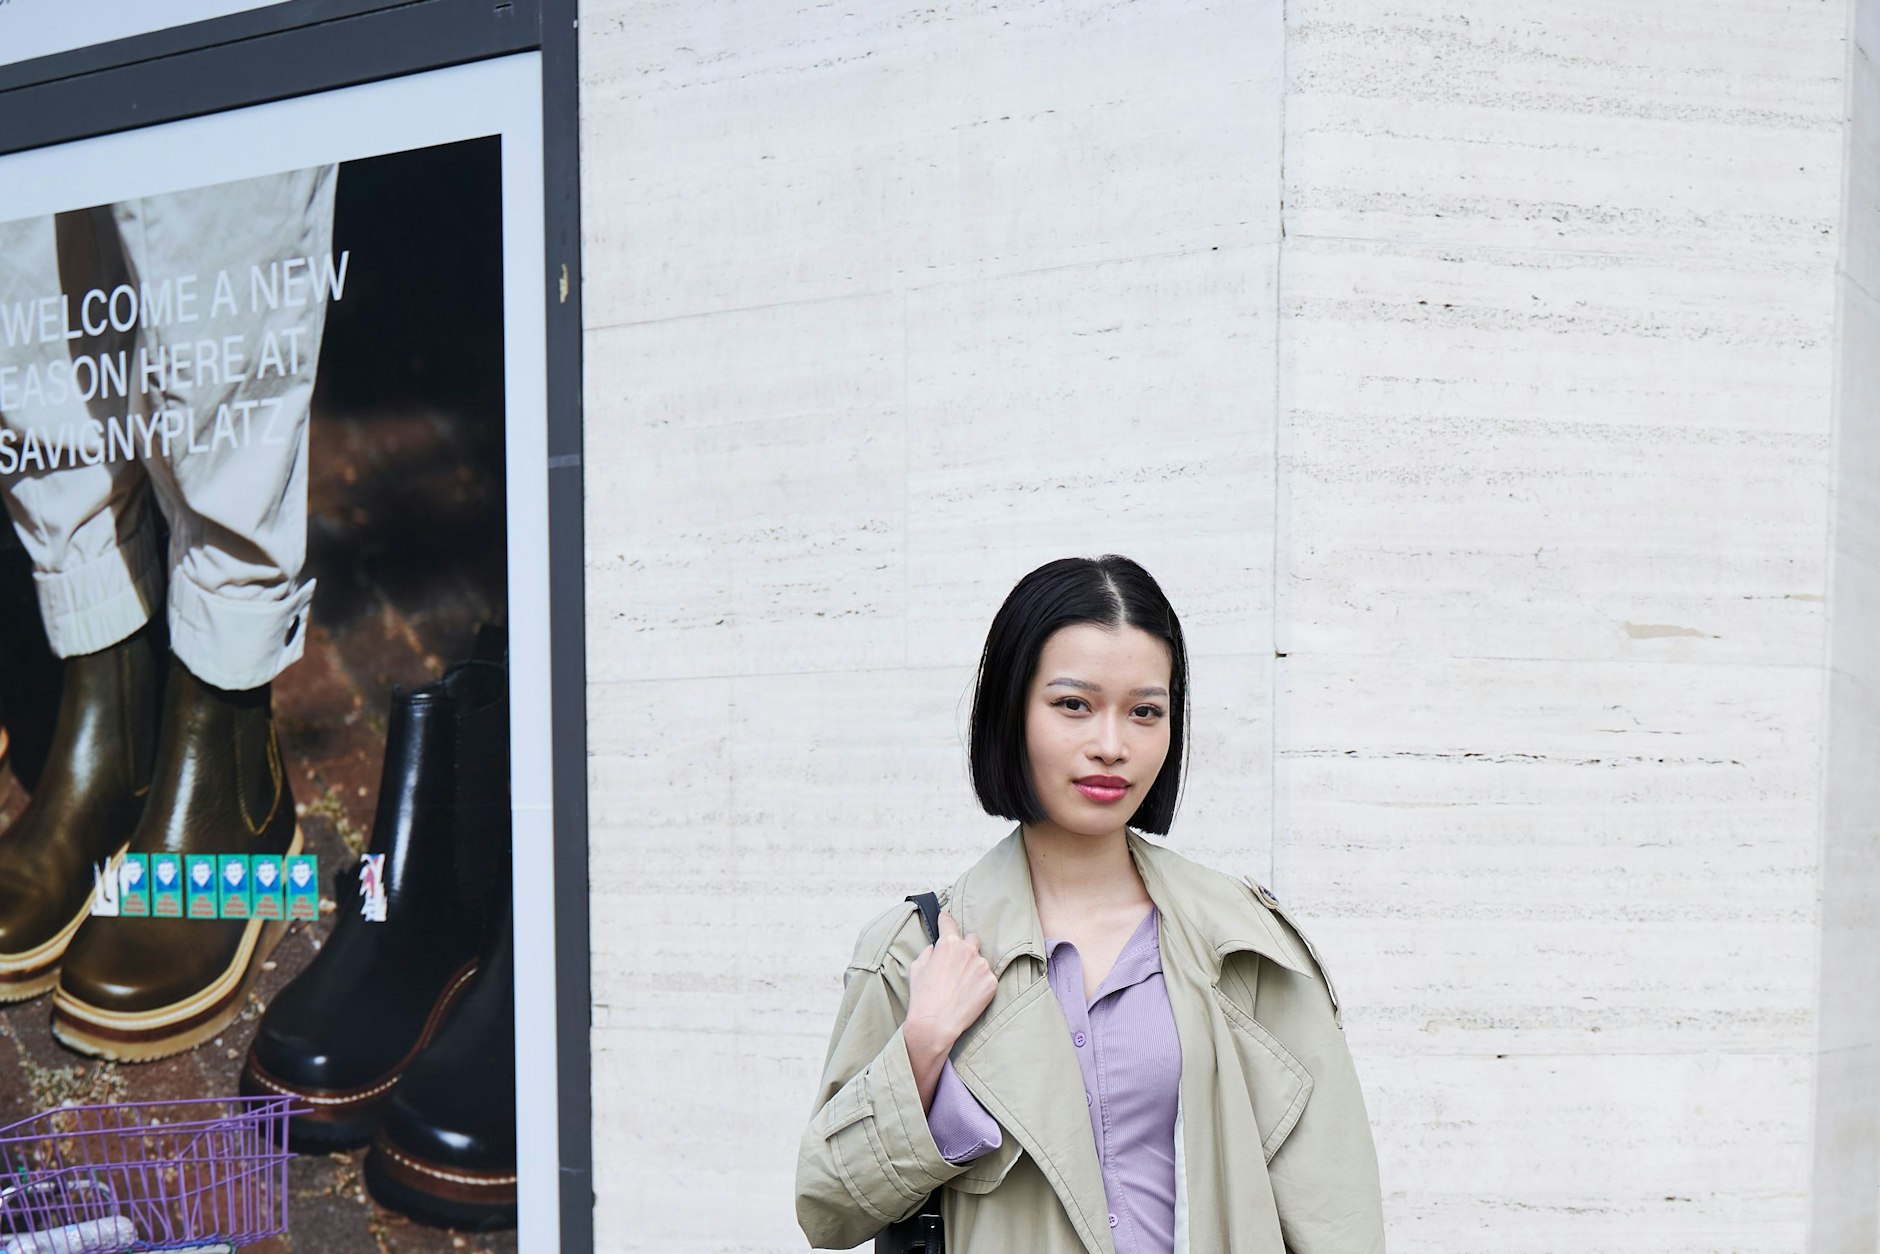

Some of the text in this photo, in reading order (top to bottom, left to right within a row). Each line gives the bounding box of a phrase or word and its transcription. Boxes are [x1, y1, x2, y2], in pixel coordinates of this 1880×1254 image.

[1, 251, 350, 347] WELCOME A NEW
[140, 335, 246, 394] HERE
[257, 327, 306, 379] AT
[0, 397, 286, 475] SAVIGNYPLATZ
